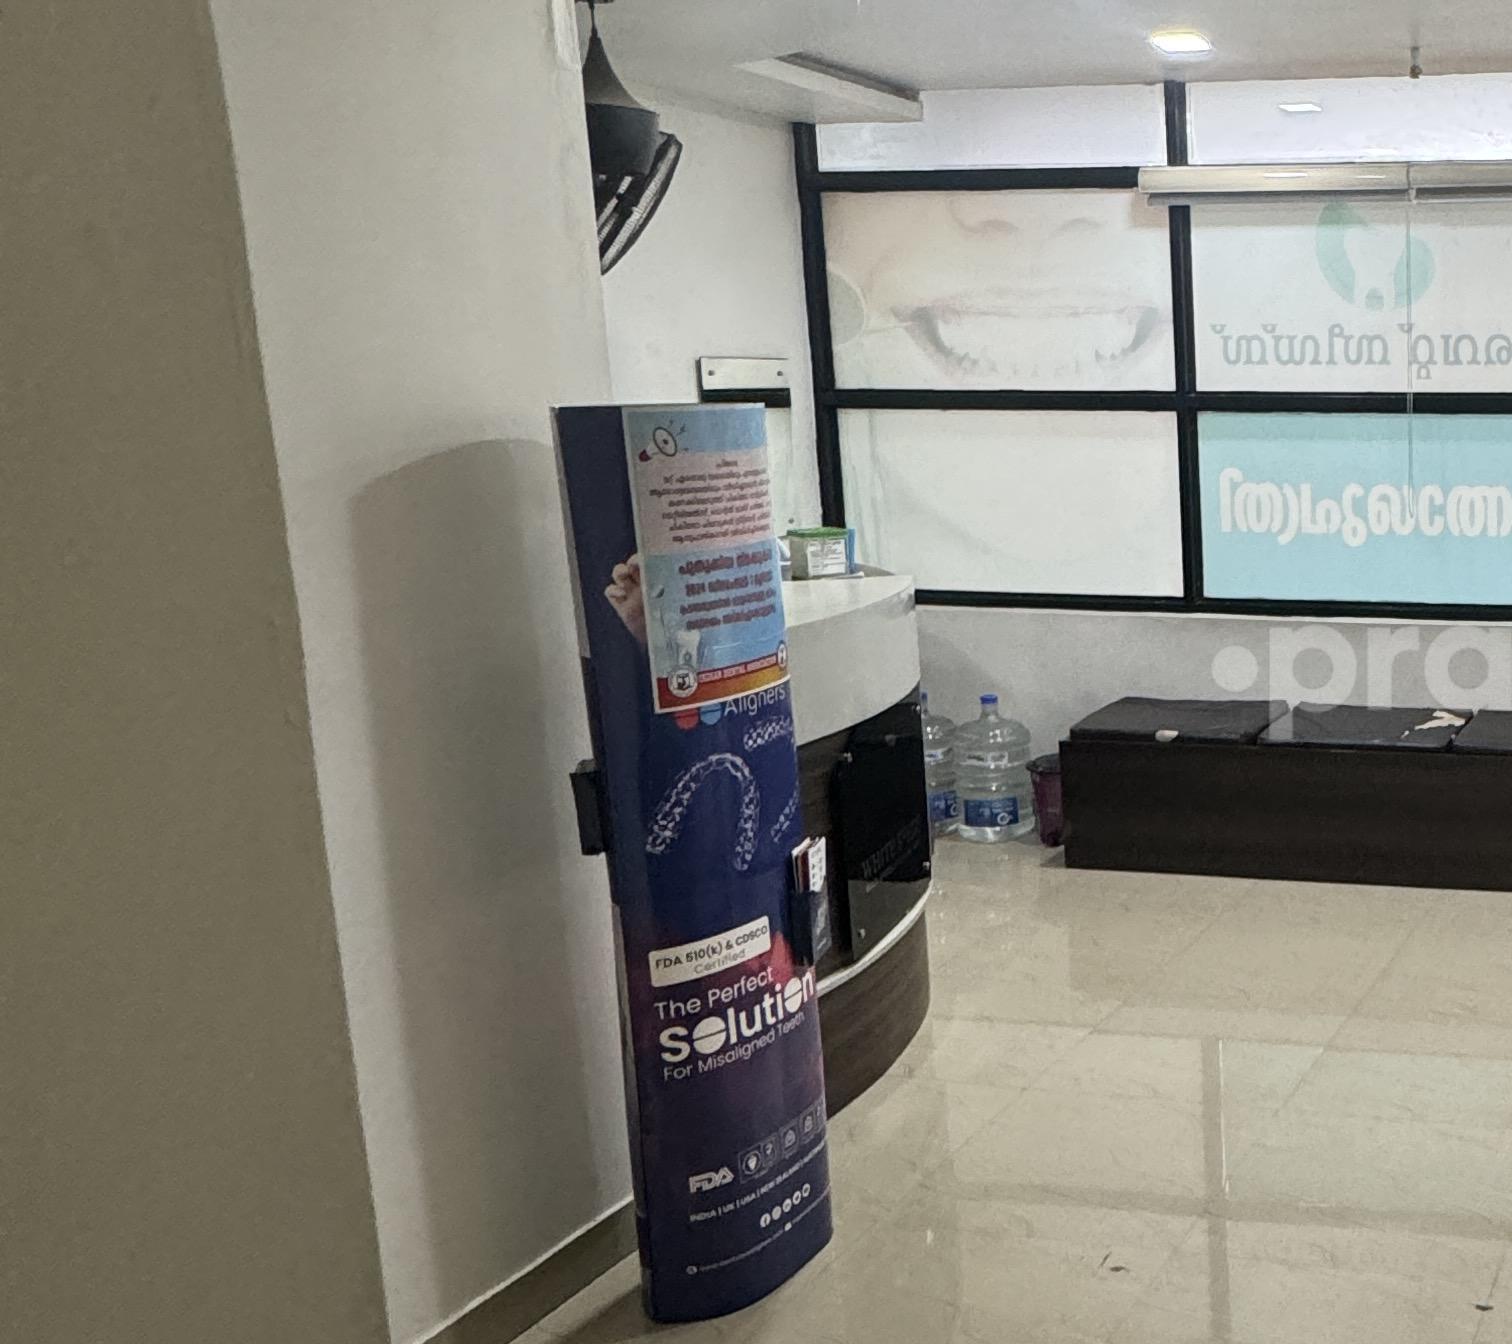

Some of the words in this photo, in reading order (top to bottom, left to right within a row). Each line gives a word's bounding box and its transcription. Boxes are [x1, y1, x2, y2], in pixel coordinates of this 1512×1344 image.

[654, 953, 683, 970] FDA
[685, 942, 722, 962] 510(k)
[726, 937, 734, 950] &
[735, 925, 768, 946] CDSCO
[654, 997, 701, 1021] The
[707, 966, 774, 1009] Perfect
[663, 1061, 693, 1082] For
[698, 1028, 775, 1074] Misaligned
[689, 1166, 734, 1194] FDA
